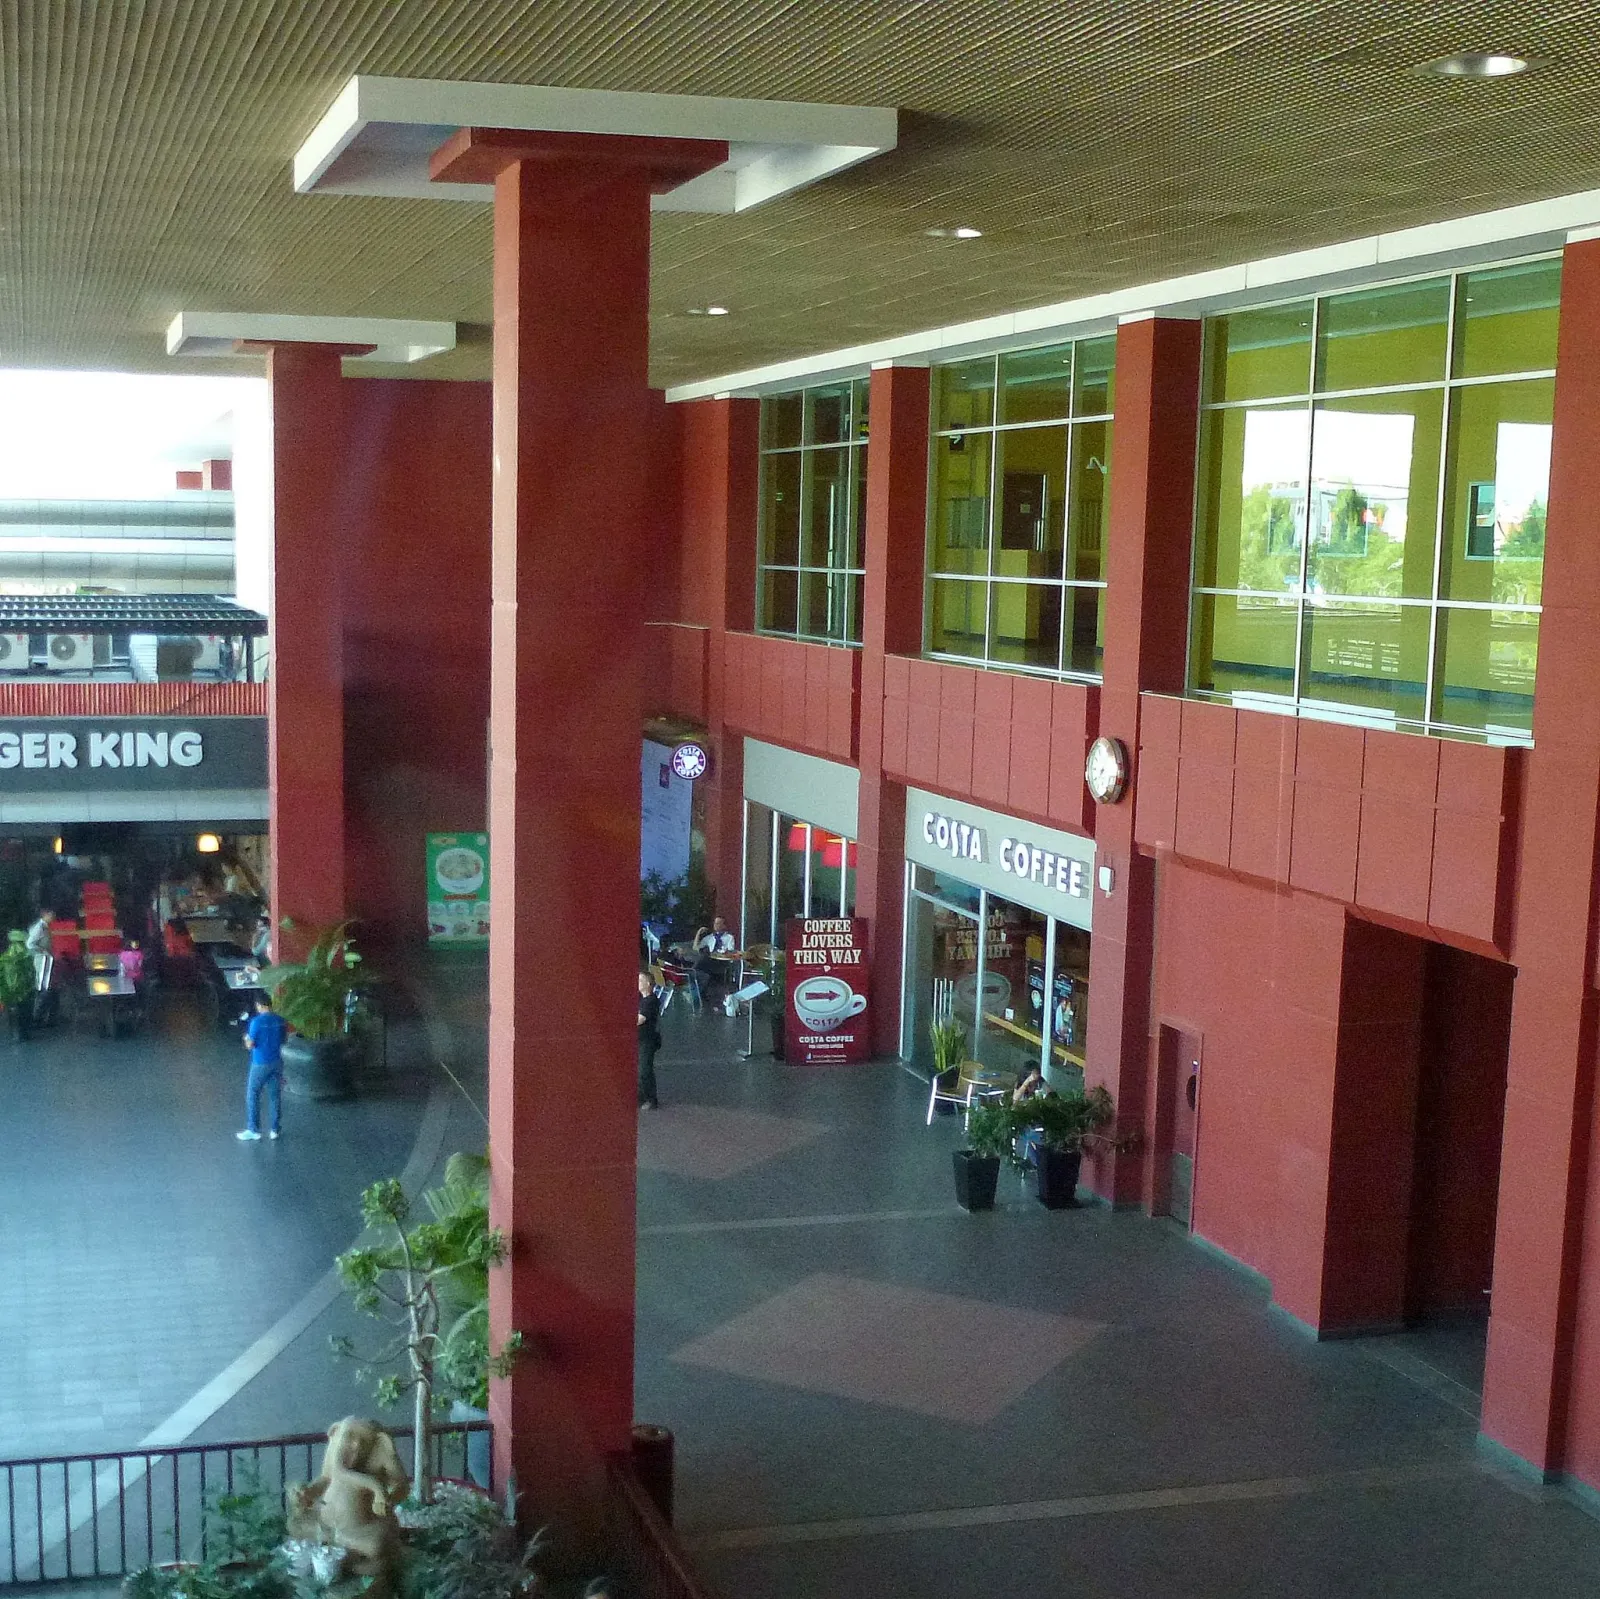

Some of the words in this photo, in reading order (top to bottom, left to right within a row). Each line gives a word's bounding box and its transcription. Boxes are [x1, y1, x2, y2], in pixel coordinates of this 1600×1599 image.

[90, 731, 204, 768] KING
[678, 747, 700, 757] COSTA
[677, 765, 703, 777] COFFEE
[923, 812, 983, 863] COSTA
[1000, 838, 1085, 898] COFFEE
[804, 919, 851, 933] COFFEE
[802, 934, 853, 948] LOVERS
[793, 950, 827, 965] THIS
[831, 949, 861, 964] WAY
[805, 1017, 840, 1027] COSTA
